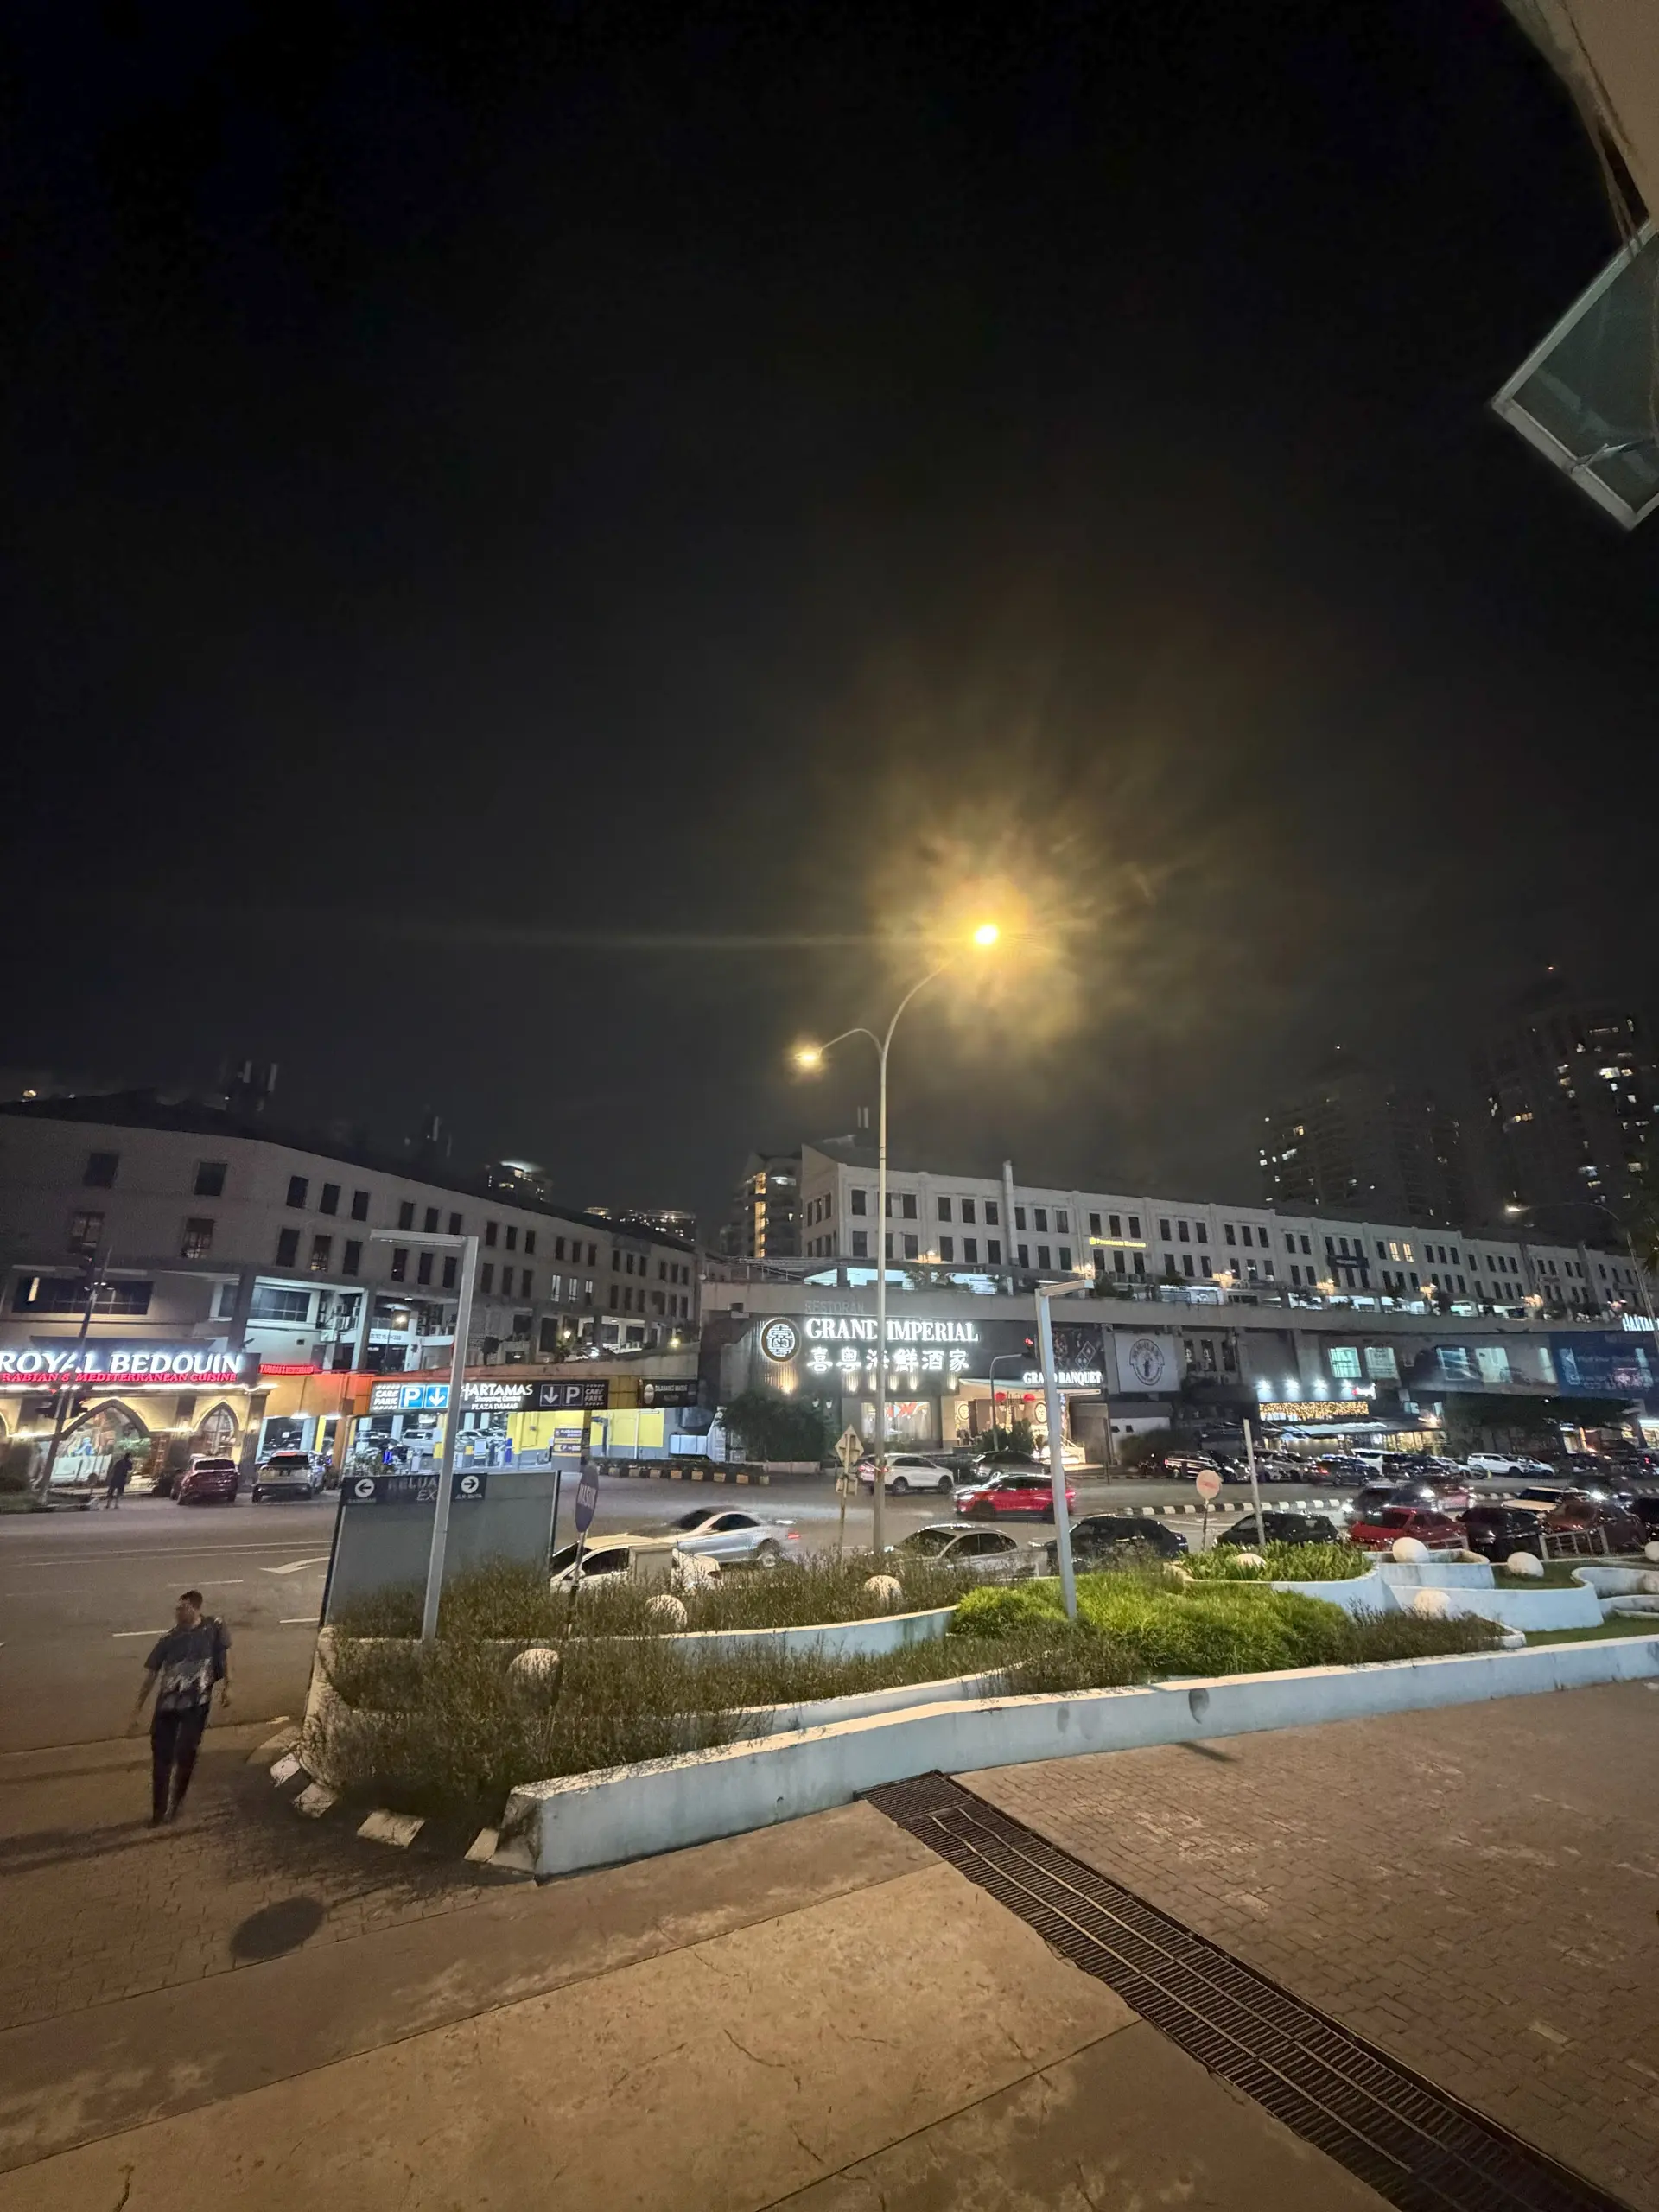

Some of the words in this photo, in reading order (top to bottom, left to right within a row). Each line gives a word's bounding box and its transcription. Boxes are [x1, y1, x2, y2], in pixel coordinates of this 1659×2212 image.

[804, 1300, 864, 1314] RESTORAN
[805, 1318, 878, 1340] GRAND
[887, 1319, 979, 1342] IMPERIAL
[0, 1351, 102, 1373] ROYAL
[110, 1353, 243, 1374] BEDOUIN
[75, 1373, 188, 1382] MEDITERRANEAN
[190, 1373, 238, 1382] CUISINE
[1058, 1371, 1102, 1386] BANQUET
[404, 1388, 421, 1407] P
[461, 1382, 533, 1401] HARTAMAS
[566, 1386, 580, 1404] P
